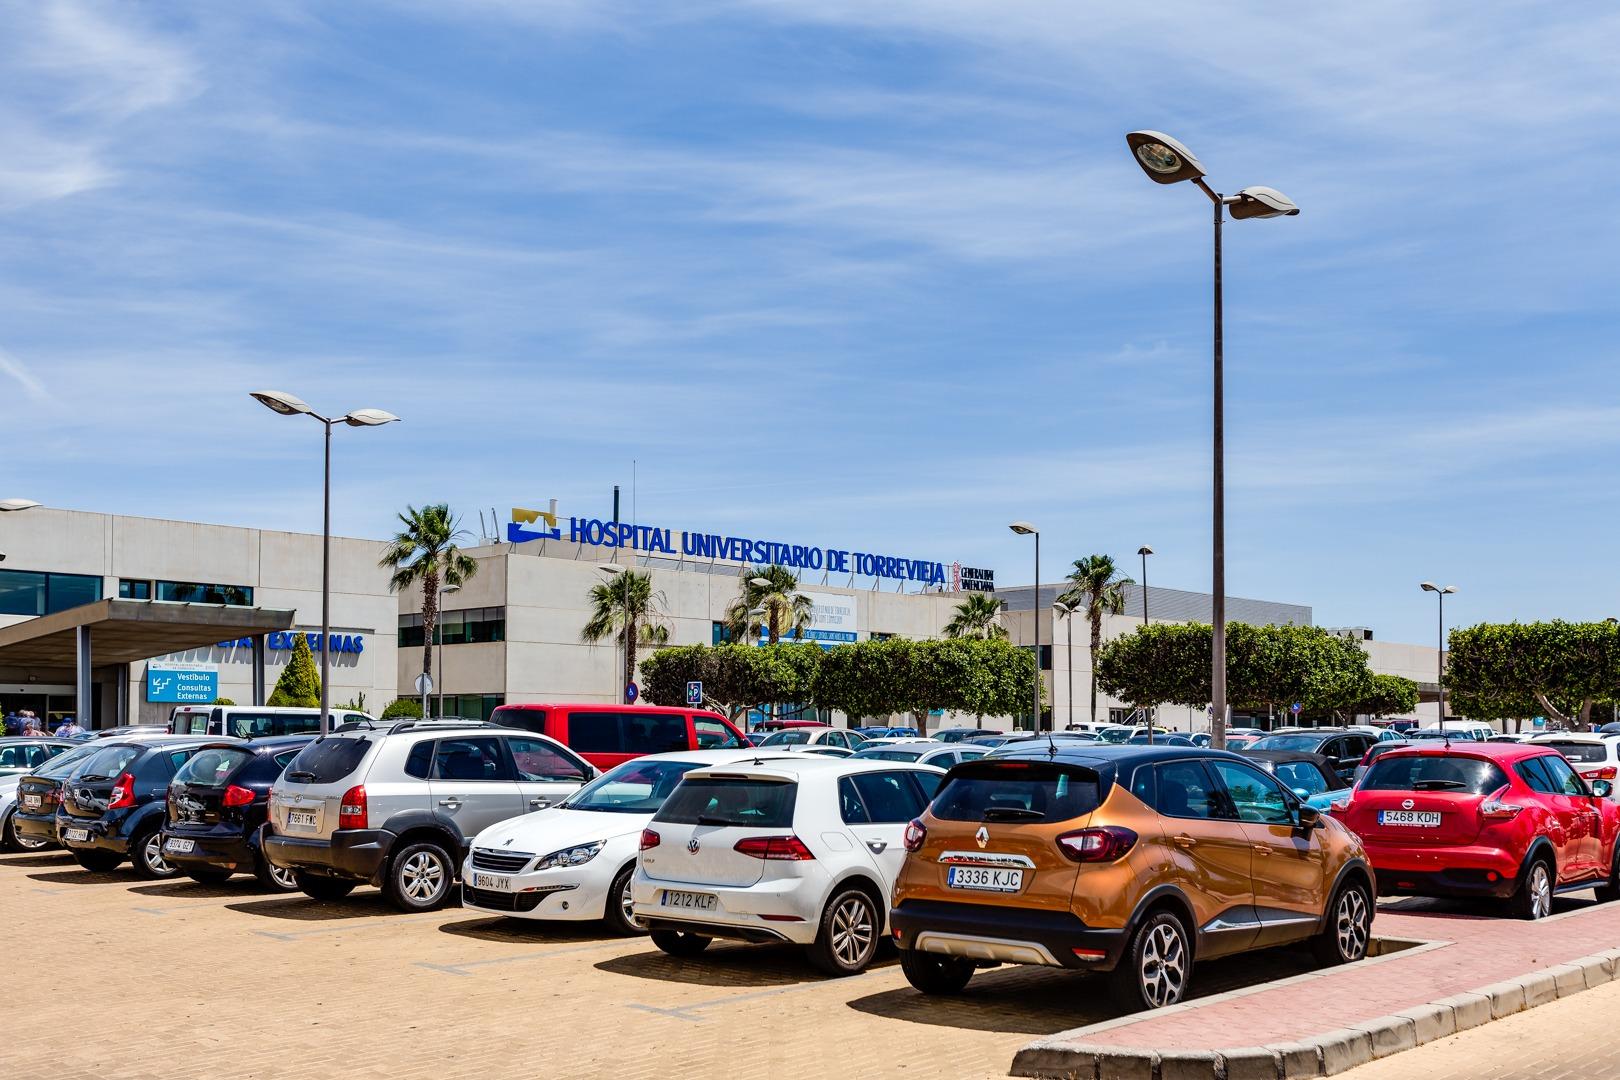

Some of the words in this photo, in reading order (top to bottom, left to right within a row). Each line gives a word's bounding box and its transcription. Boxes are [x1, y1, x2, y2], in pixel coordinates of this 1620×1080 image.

[570, 516, 677, 555] HOSPITAL
[682, 531, 823, 570] UNIVERSITARIO
[827, 548, 850, 573] DE
[854, 552, 946, 586] TORREVIEJA
[268, 631, 364, 653] EXENAS
[177, 684, 212, 692] Consultas
[177, 692, 208, 700] Externas
[1386, 811, 1414, 822] 5468
[1417, 812, 1439, 823] KDH
[477, 875, 493, 888] 9604
[495, 877, 509, 889] JYX
[956, 869, 989, 885] 3336
[992, 871, 1019, 887] KJC
[668, 892, 691, 907] 1212
[694, 894, 715, 910] KLF
